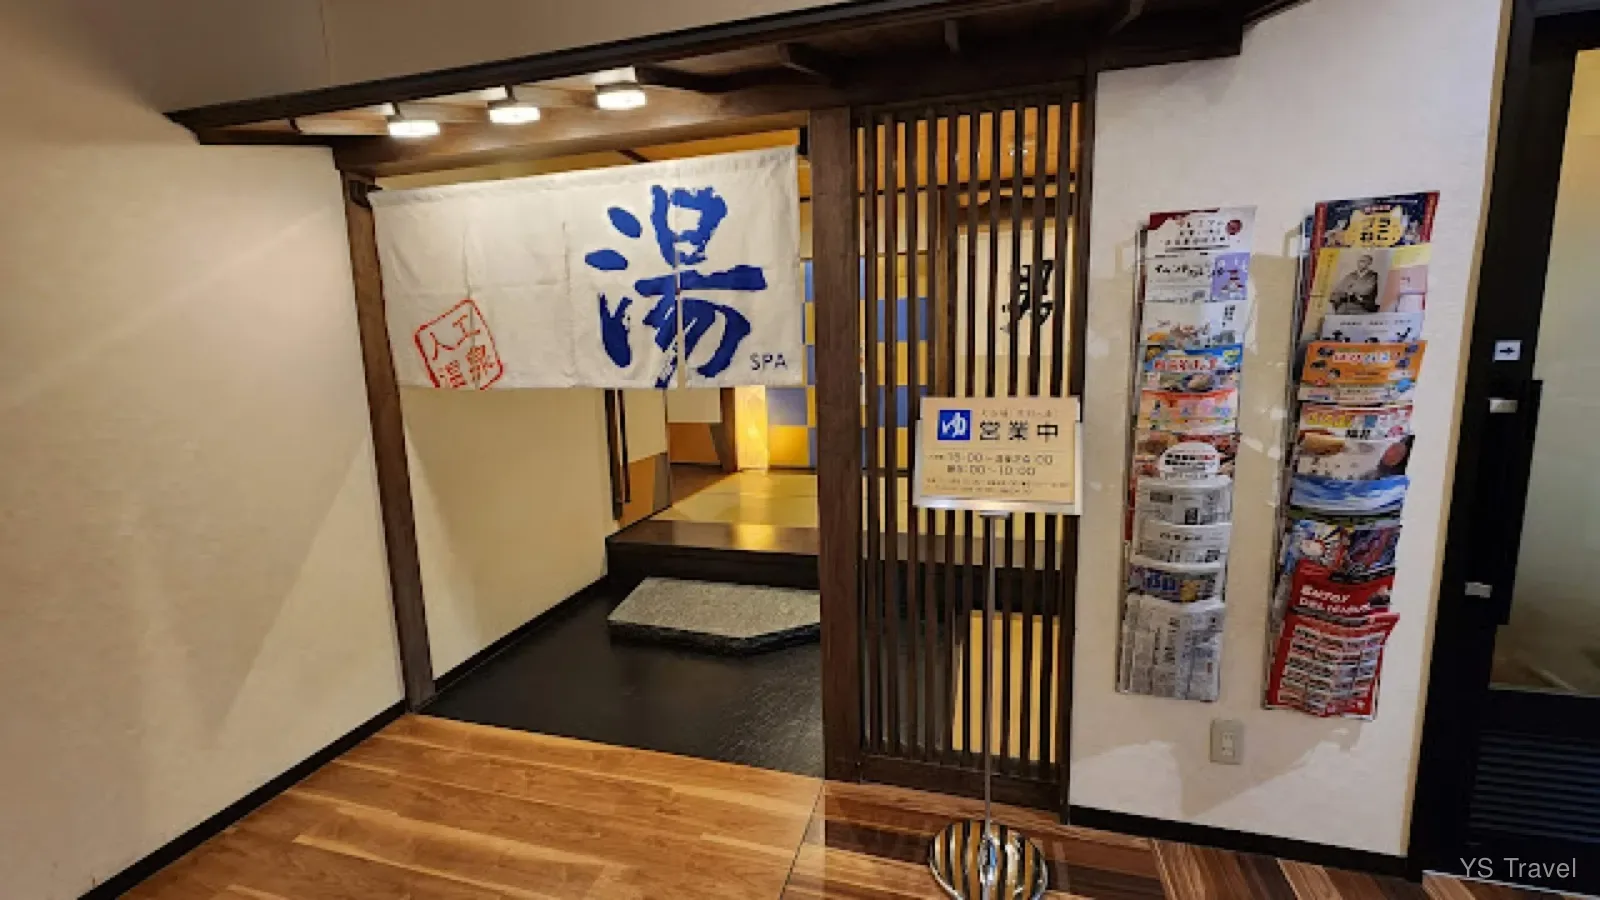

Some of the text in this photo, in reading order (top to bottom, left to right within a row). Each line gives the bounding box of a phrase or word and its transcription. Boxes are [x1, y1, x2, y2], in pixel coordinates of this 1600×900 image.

[585, 184, 768, 388] 湯
[749, 353, 789, 371] SPA
[941, 411, 967, 439] ゆ
[979, 420, 1059, 443] 営業中
